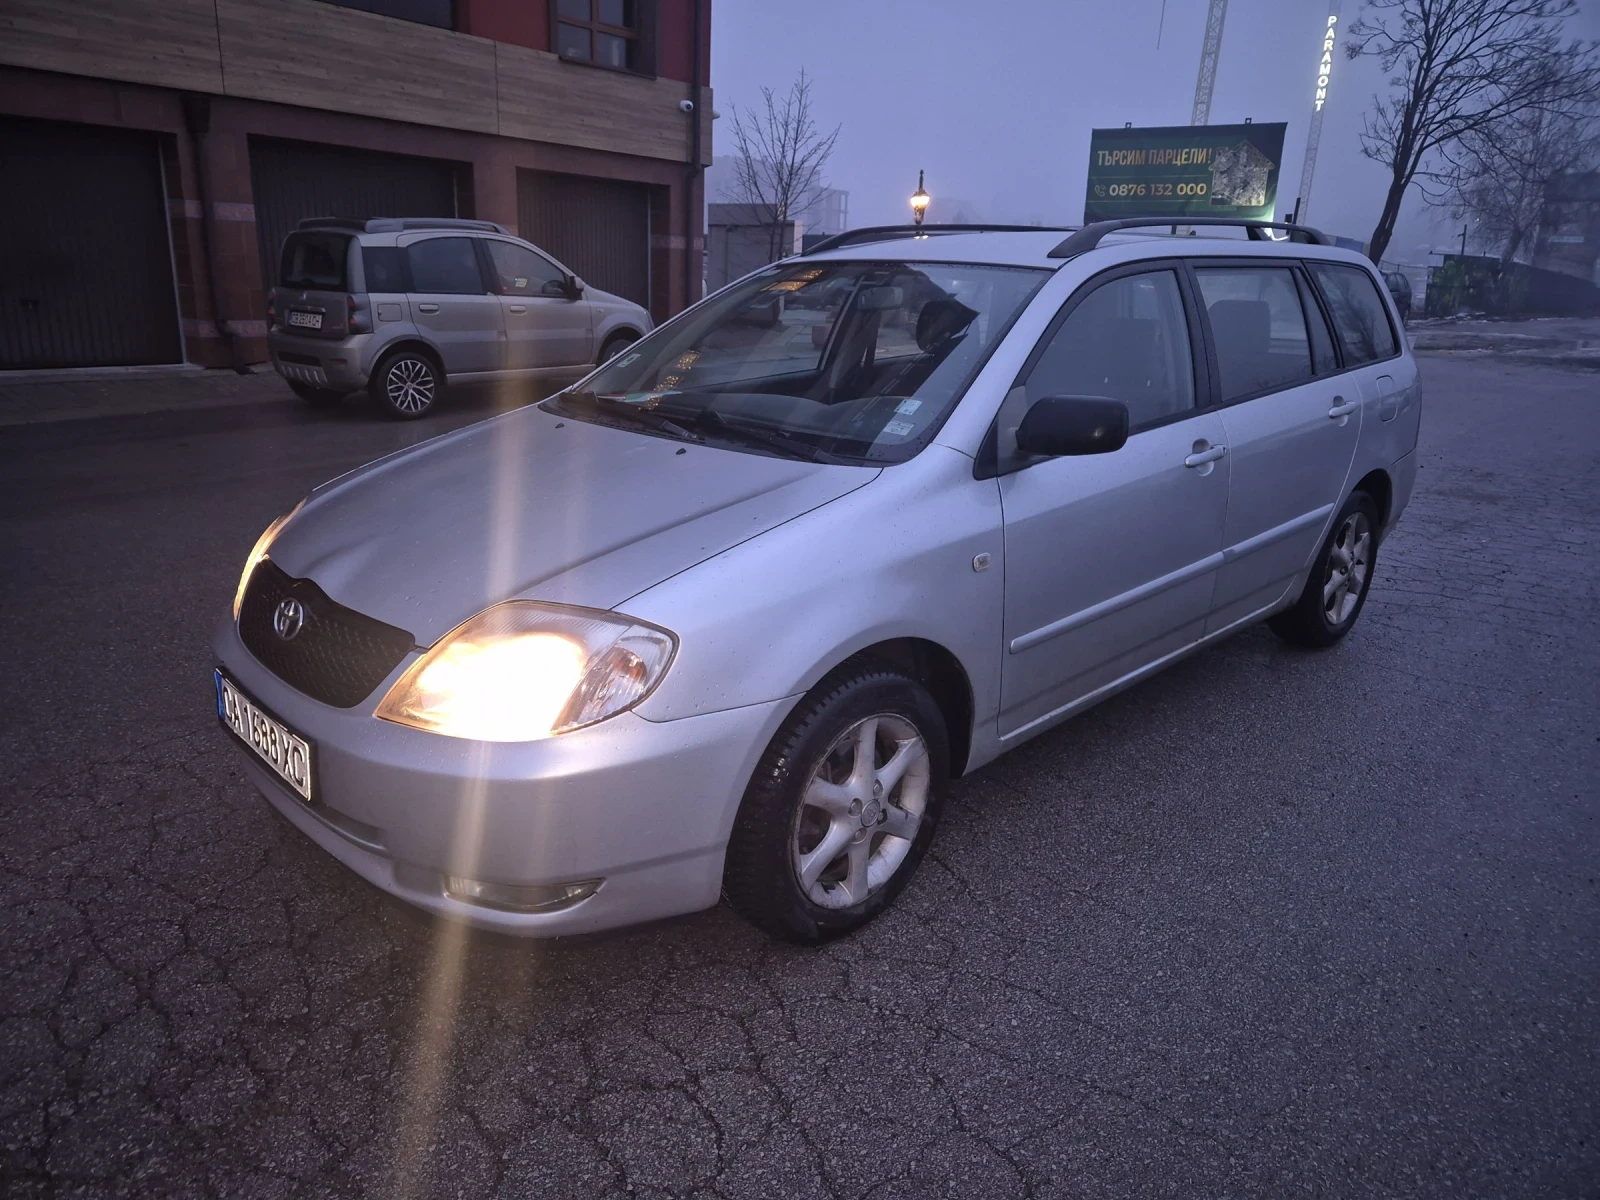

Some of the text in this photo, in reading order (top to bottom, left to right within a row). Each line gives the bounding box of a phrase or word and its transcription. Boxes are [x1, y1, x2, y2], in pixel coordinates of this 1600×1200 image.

[1315, 15, 1337, 112] PARAMONT
[1098, 148, 1212, 166] ТЪРСИМ ПАРЦЕЛИ!
[1109, 183, 1207, 196] 0876 132 000
